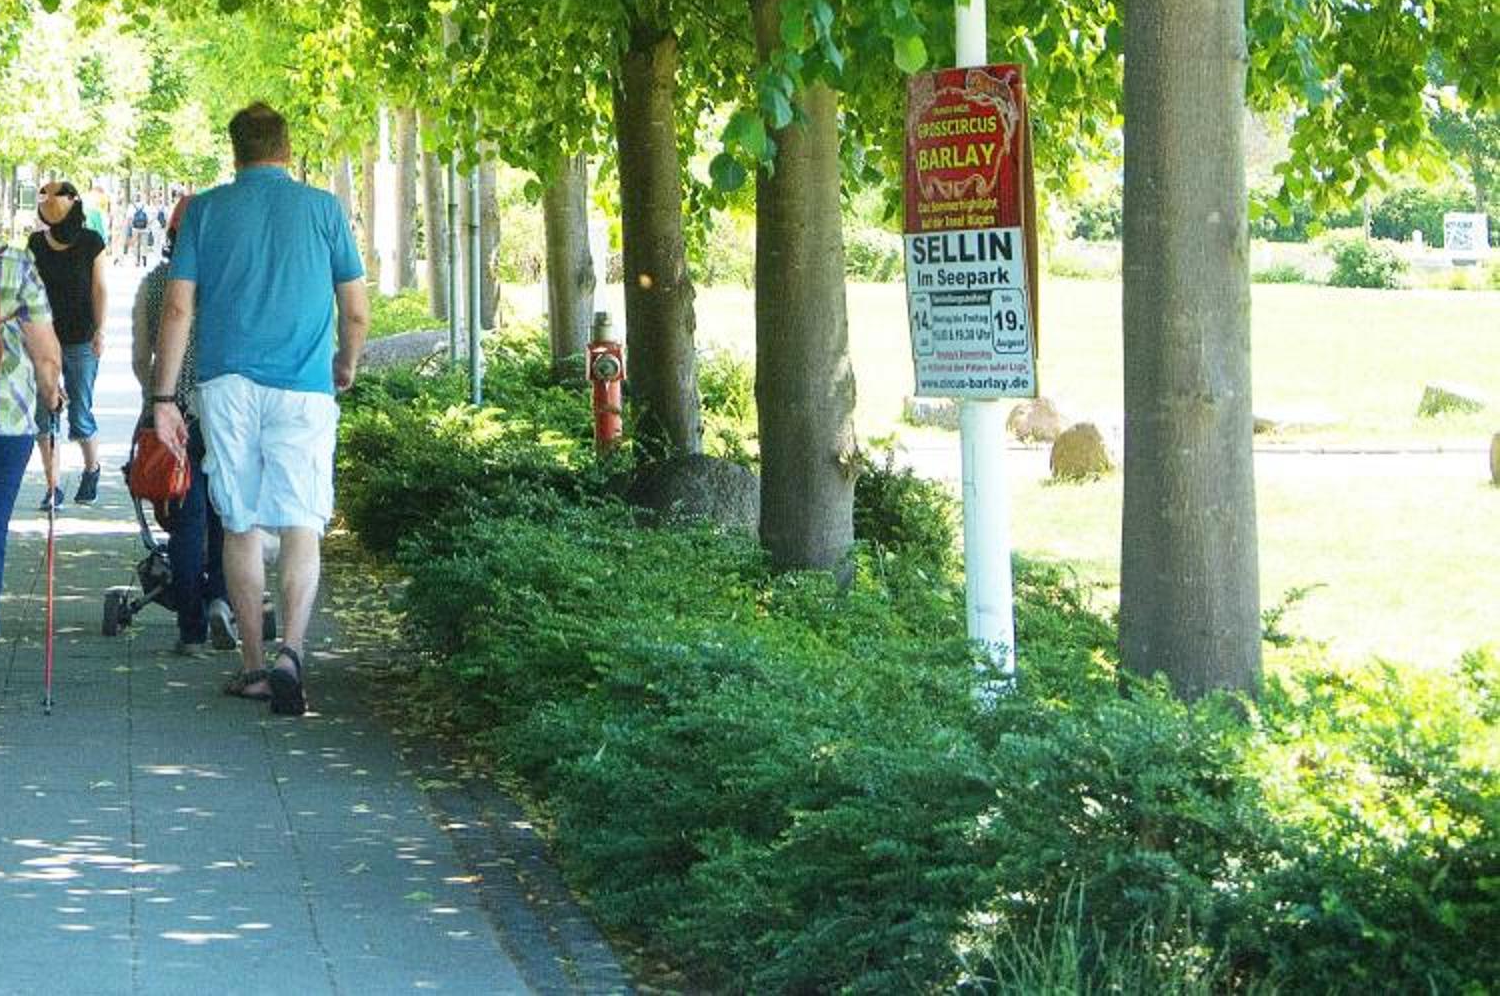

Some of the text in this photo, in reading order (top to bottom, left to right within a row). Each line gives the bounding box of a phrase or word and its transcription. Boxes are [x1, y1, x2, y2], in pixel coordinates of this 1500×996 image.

[918, 143, 996, 171] BARLAY
[913, 231, 1013, 265] SELLIN
[917, 265, 1011, 289] Im Seepark
[994, 310, 1025, 331] 19.
